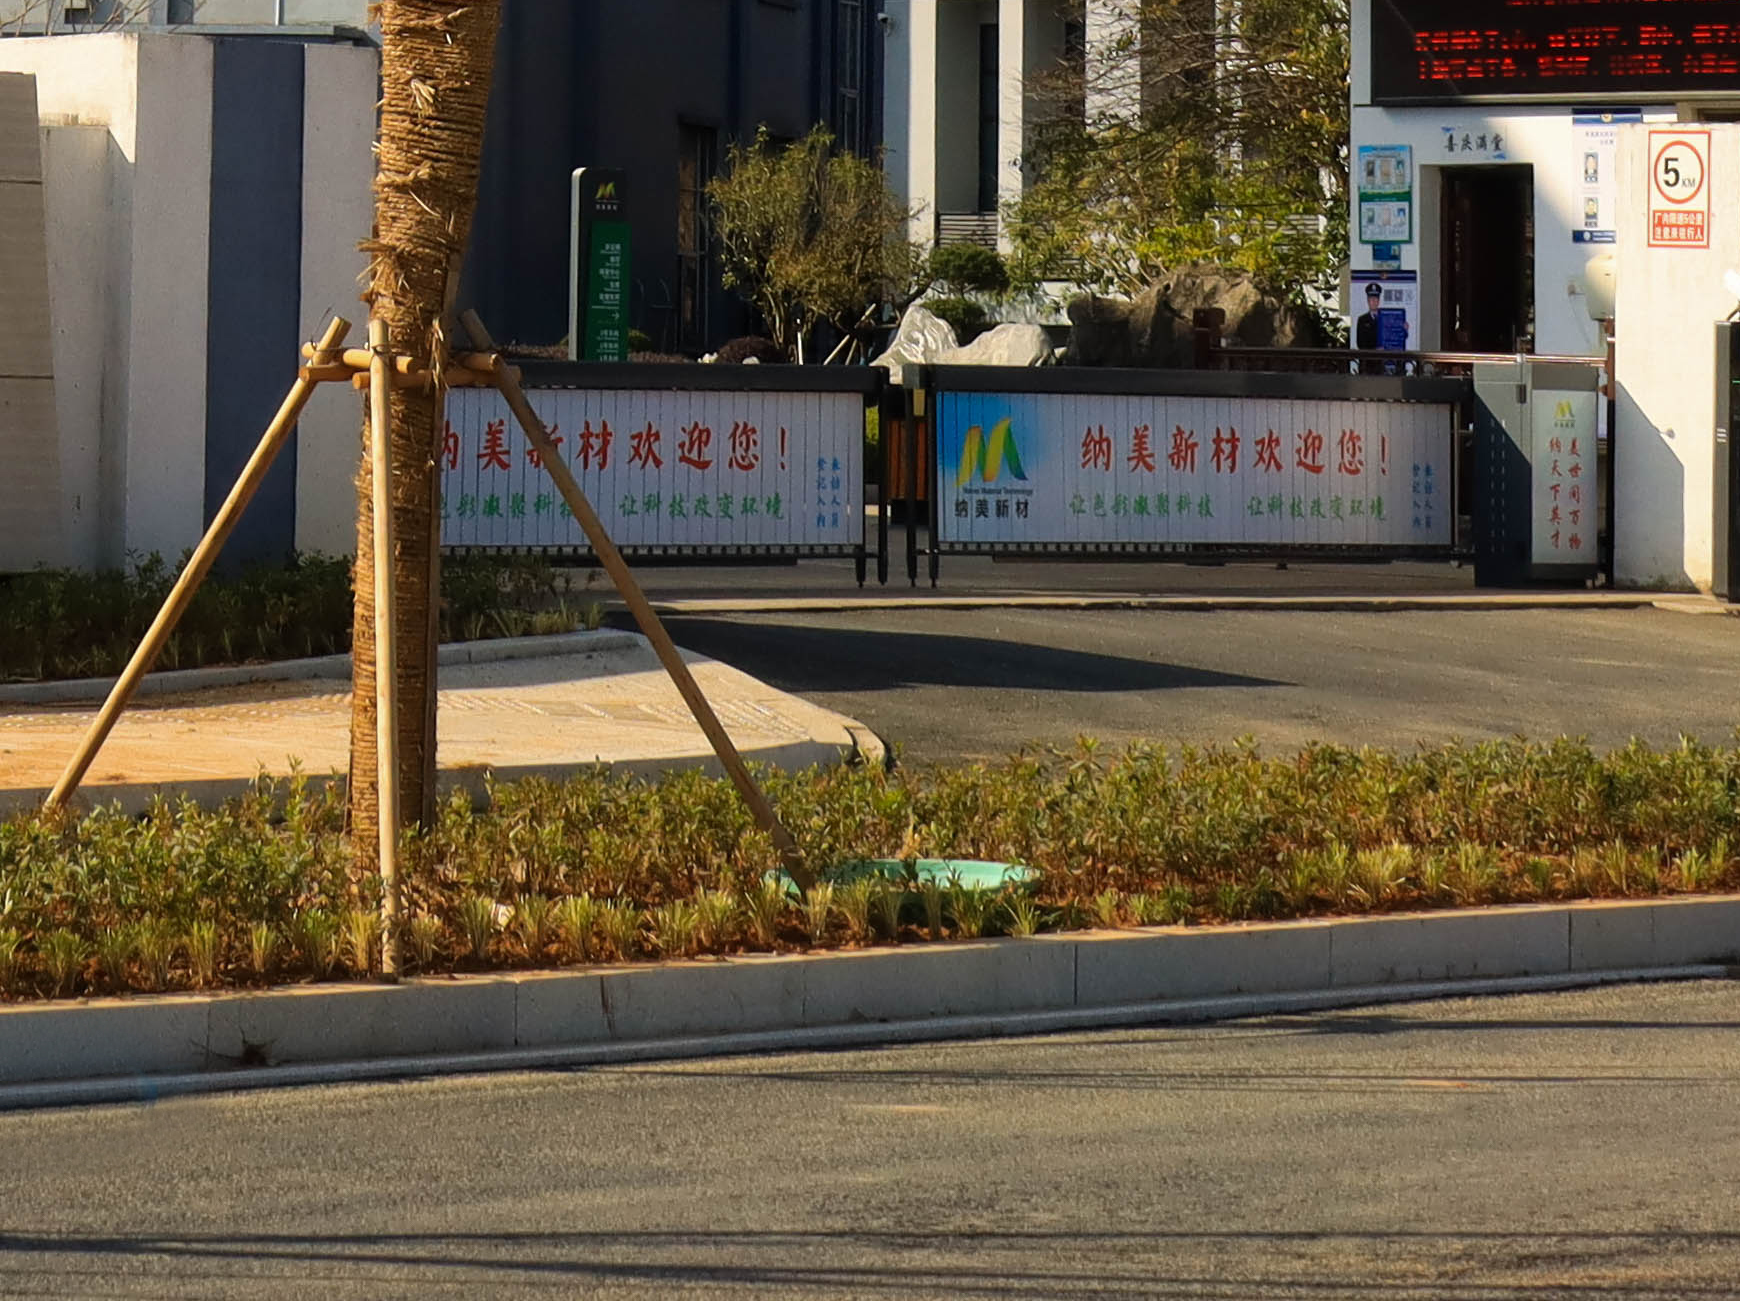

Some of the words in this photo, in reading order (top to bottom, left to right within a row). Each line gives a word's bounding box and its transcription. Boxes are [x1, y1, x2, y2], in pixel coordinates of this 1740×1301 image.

[1663, 157, 1680, 187] 5
[1681, 178, 1696, 188] KM
[955, 498, 1029, 518] 纳美新材
